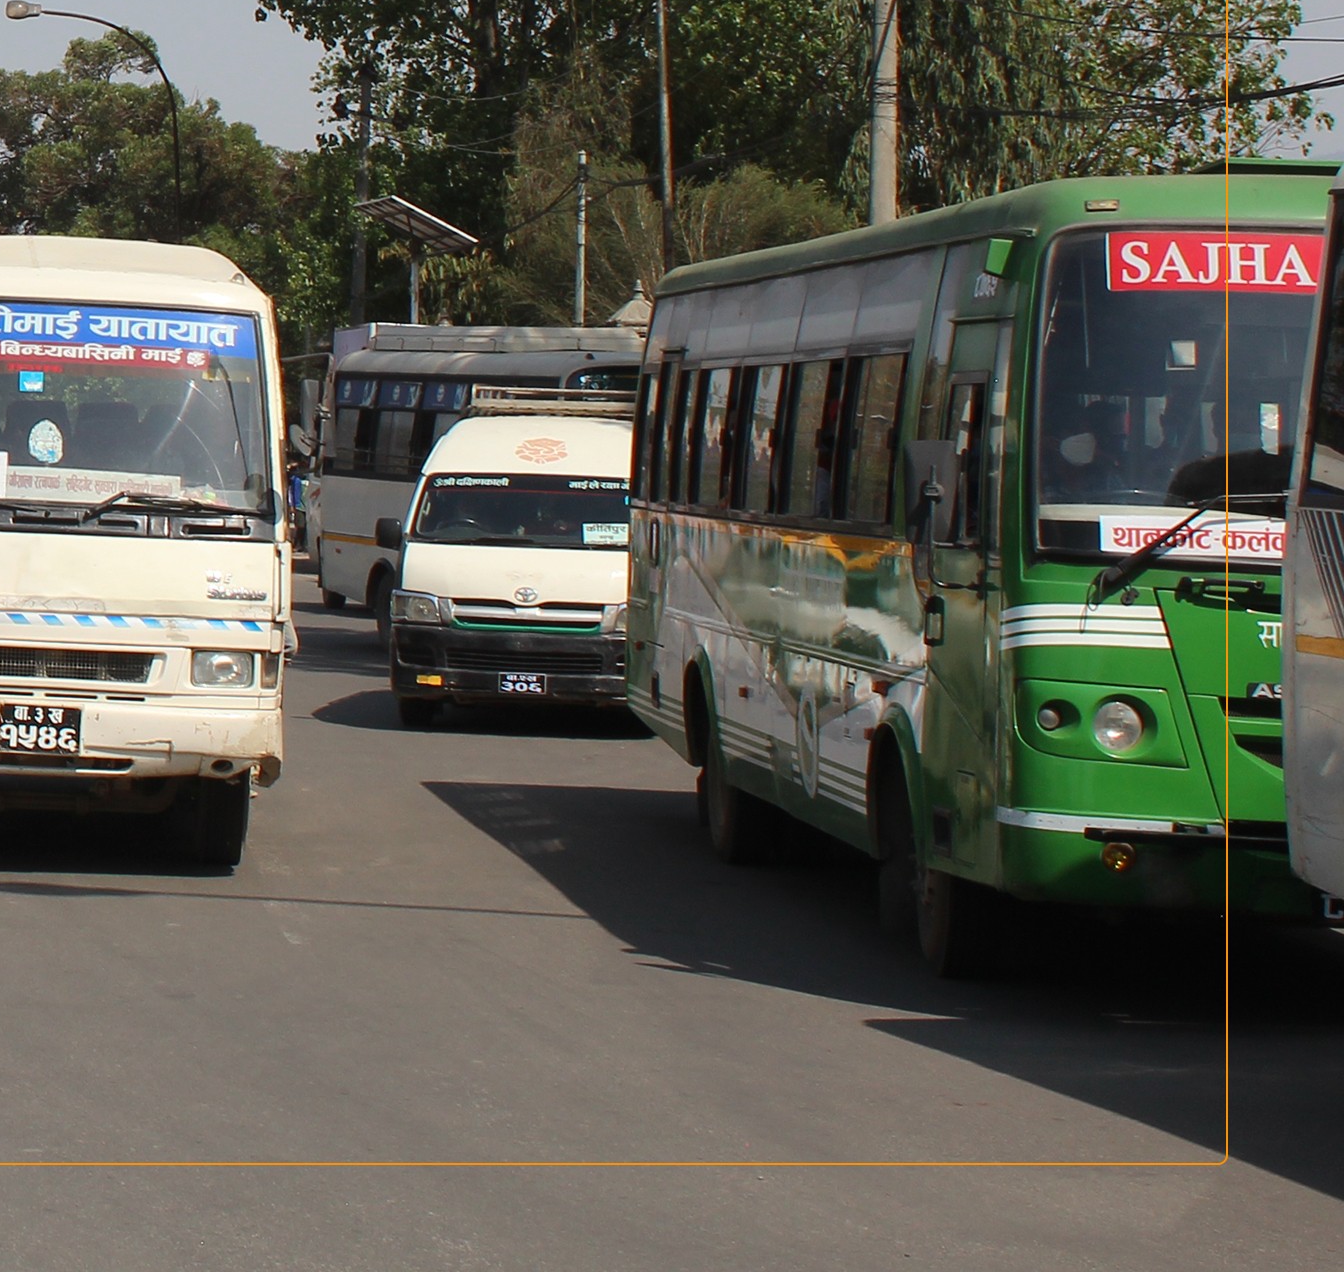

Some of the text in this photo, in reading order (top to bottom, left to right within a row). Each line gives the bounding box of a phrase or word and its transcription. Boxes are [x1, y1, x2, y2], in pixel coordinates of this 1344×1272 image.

[1120, 240, 1318, 287] SAJHA
[89, 314, 239, 347] यातायात
[141, 348, 181, 364] माई
[34, 707, 44, 723] ३
[48, 708, 64, 724] ख
[0, 724, 77, 752] १५४६
